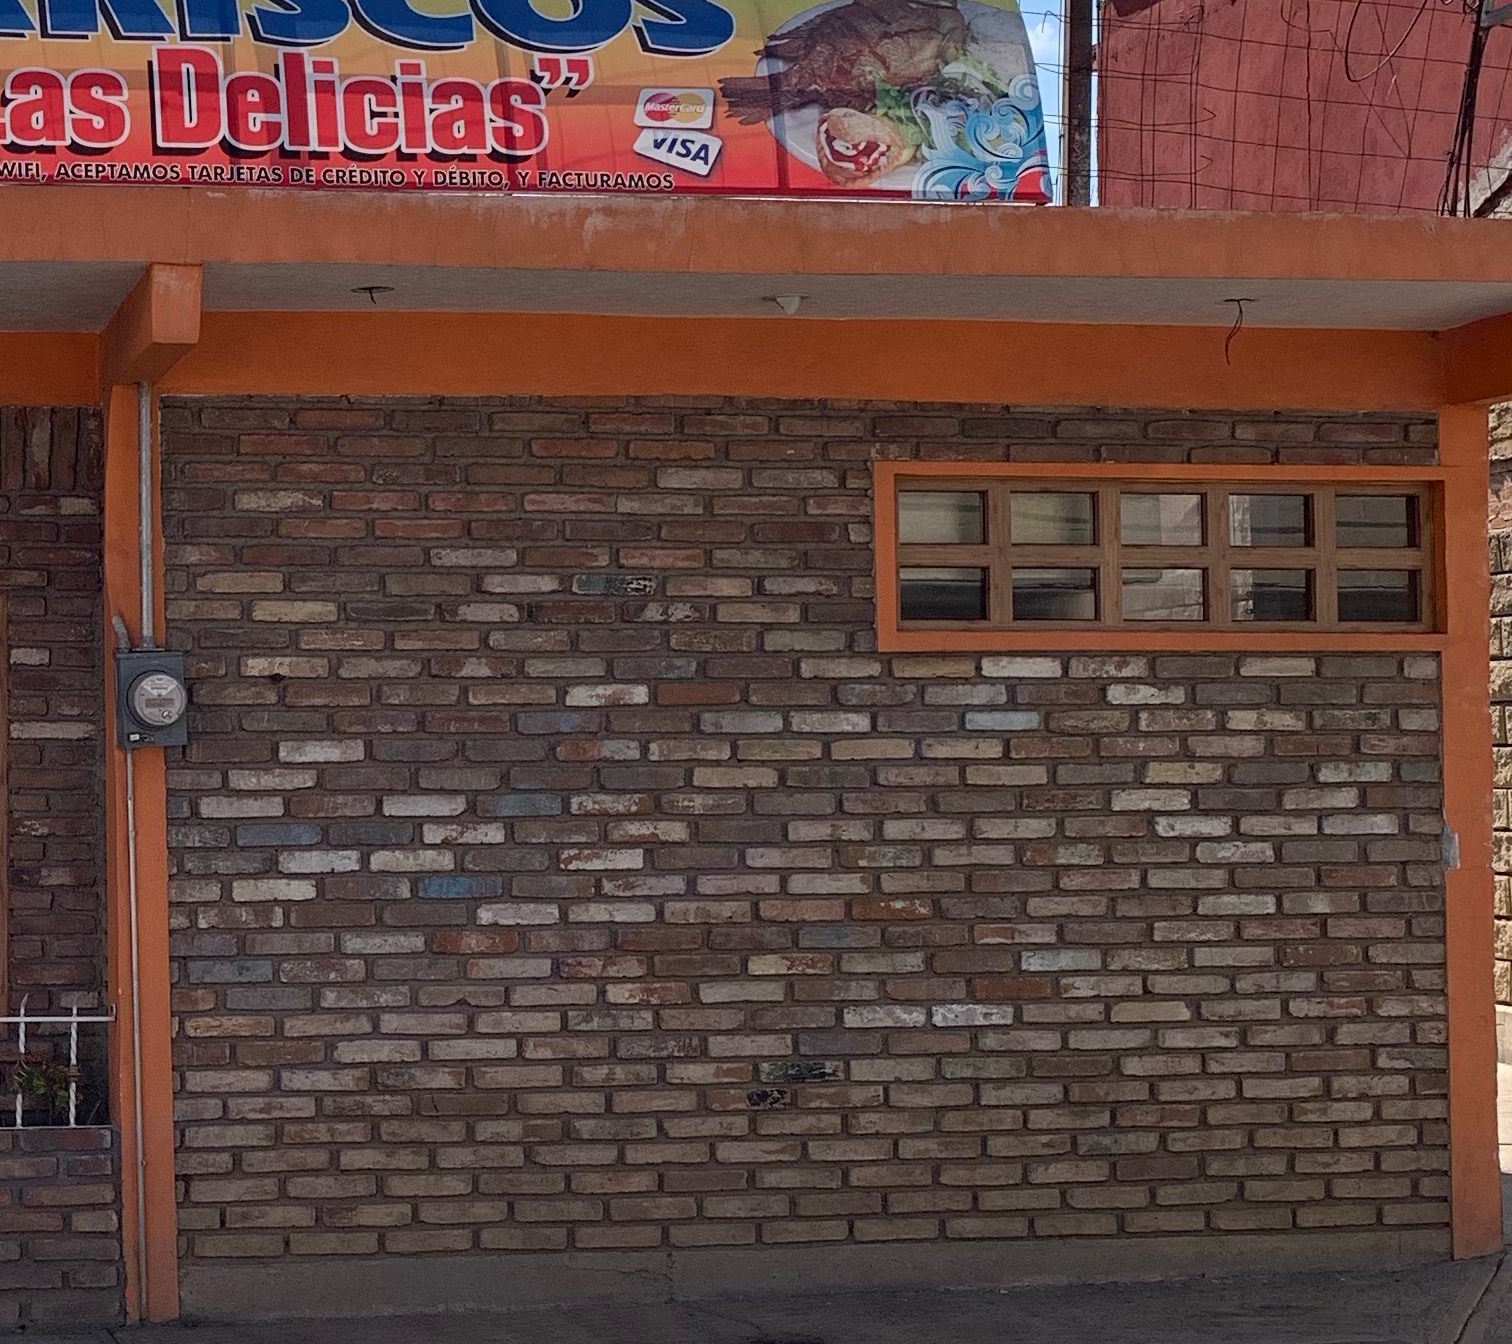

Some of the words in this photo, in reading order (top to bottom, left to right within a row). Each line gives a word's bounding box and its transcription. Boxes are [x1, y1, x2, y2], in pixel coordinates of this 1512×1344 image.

[653, 137, 710, 166] VISA
[55, 163, 182, 182] ACEPTAMOS
[186, 164, 284, 184] TARJETAS
[289, 167, 316, 184] DE
[321, 164, 407, 187] CRÉDITO
[411, 170, 428, 187] Y
[433, 166, 510, 190] DÉBITO,
[516, 170, 533, 188] Y
[537, 171, 675, 190] FACTURAMOS
